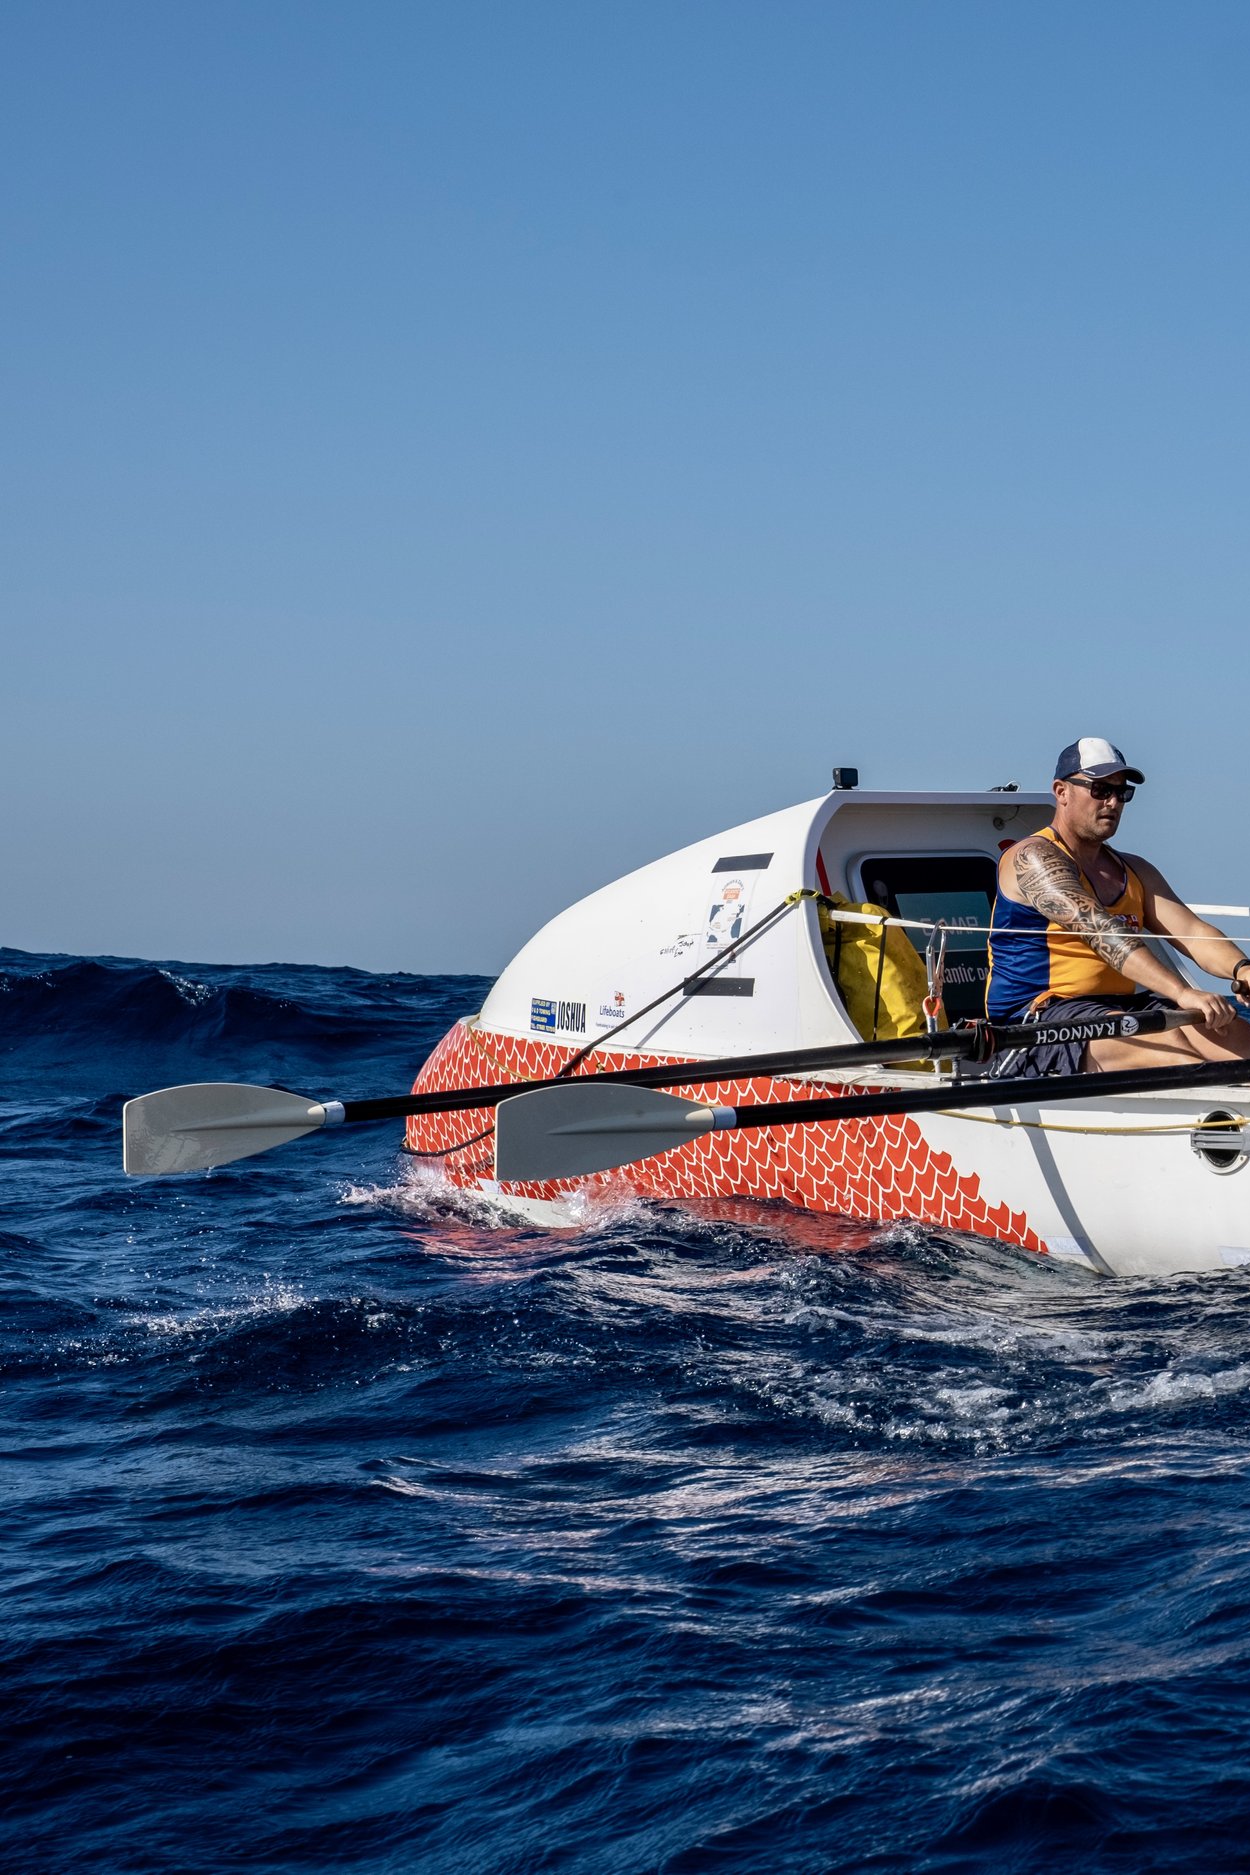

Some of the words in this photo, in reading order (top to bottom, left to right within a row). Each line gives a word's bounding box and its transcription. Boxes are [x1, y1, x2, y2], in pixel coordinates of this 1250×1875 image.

[557, 1000, 587, 1033] JOSHUA
[599, 1005, 625, 1019] Lifeboats
[1035, 1021, 1116, 1045] RANNOCH
